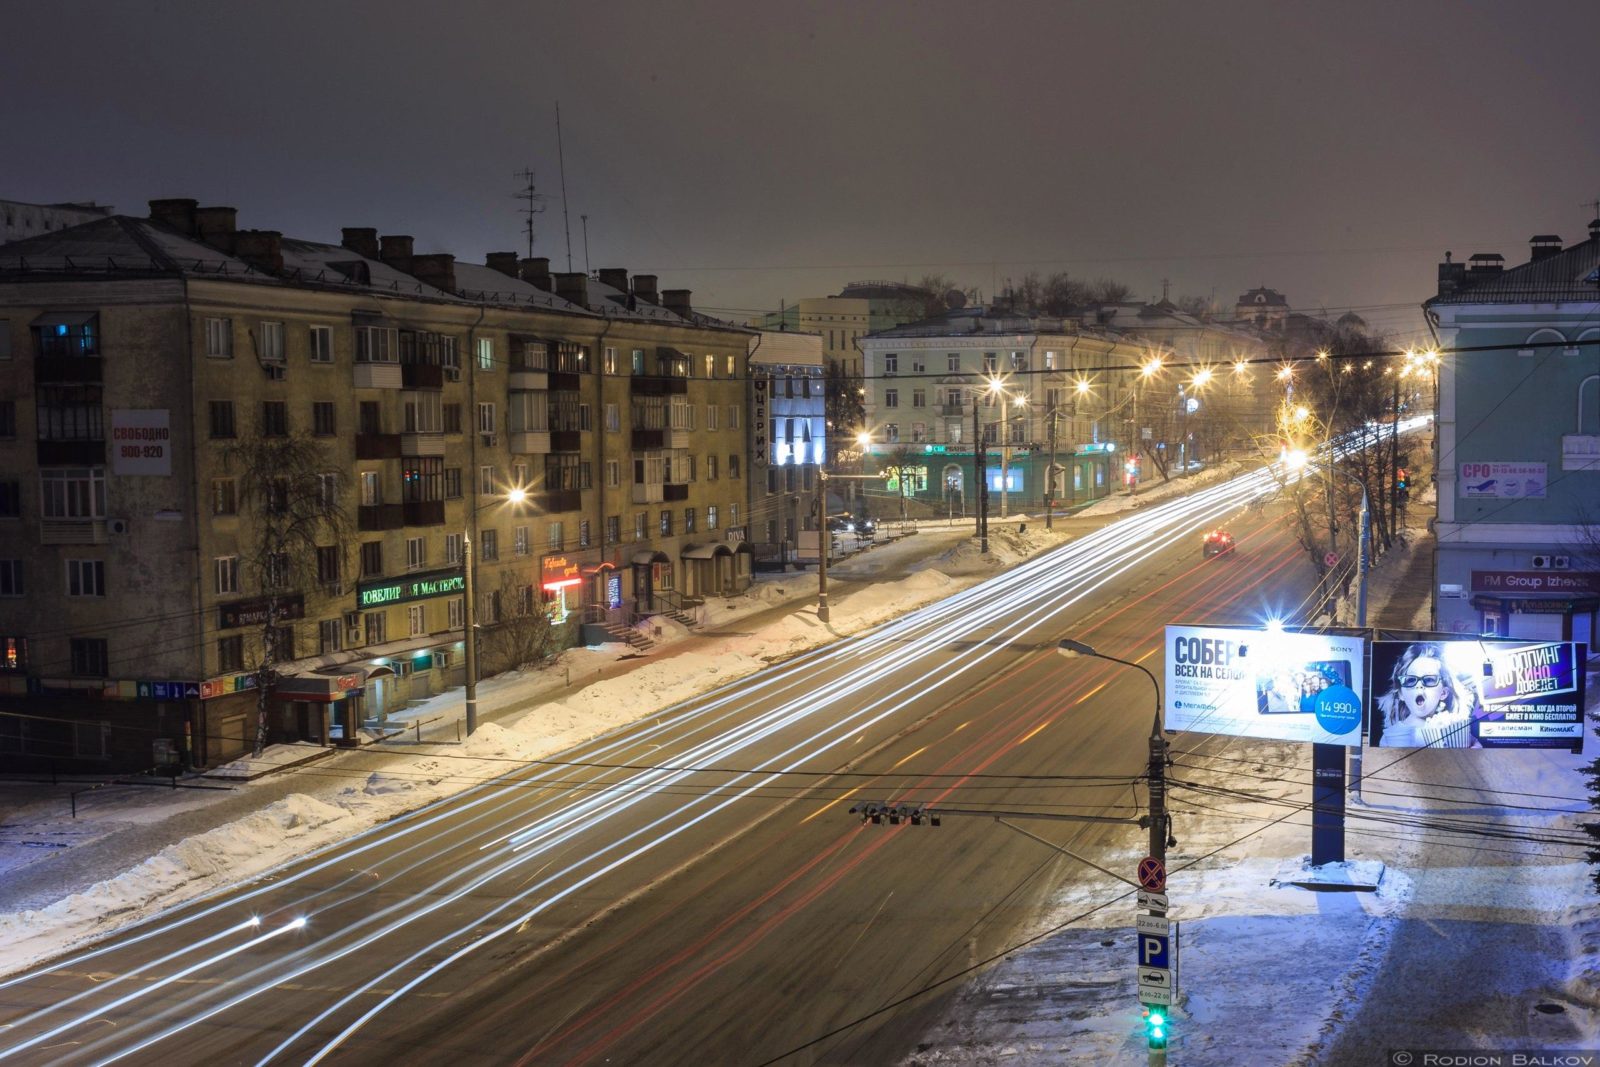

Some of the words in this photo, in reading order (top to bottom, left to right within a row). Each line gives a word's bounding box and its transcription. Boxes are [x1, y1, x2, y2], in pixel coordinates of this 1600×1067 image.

[113, 427, 169, 442] СВОБОДНО
[121, 446, 163, 458] 900-920
[1463, 464, 1491, 478] СРО
[728, 530, 746, 542] DIVA
[421, 577, 465, 595] МАСТЕРСК
[1485, 576, 1501, 586] FM
[1506, 575, 1543, 588] Group
[1175, 636, 1235, 666] СОБЕР
[1175, 664, 1198, 678] ВСЕХ
[1200, 666, 1213, 679] НА
[1514, 664, 1551, 685] КИНО
[1320, 701, 1332, 713] 14
[1335, 702, 1352, 714] 990
[1537, 704, 1555, 713] КОГДА
[1556, 704, 1577, 712] ВТОРОЙ
[1145, 937, 1162, 964] P
